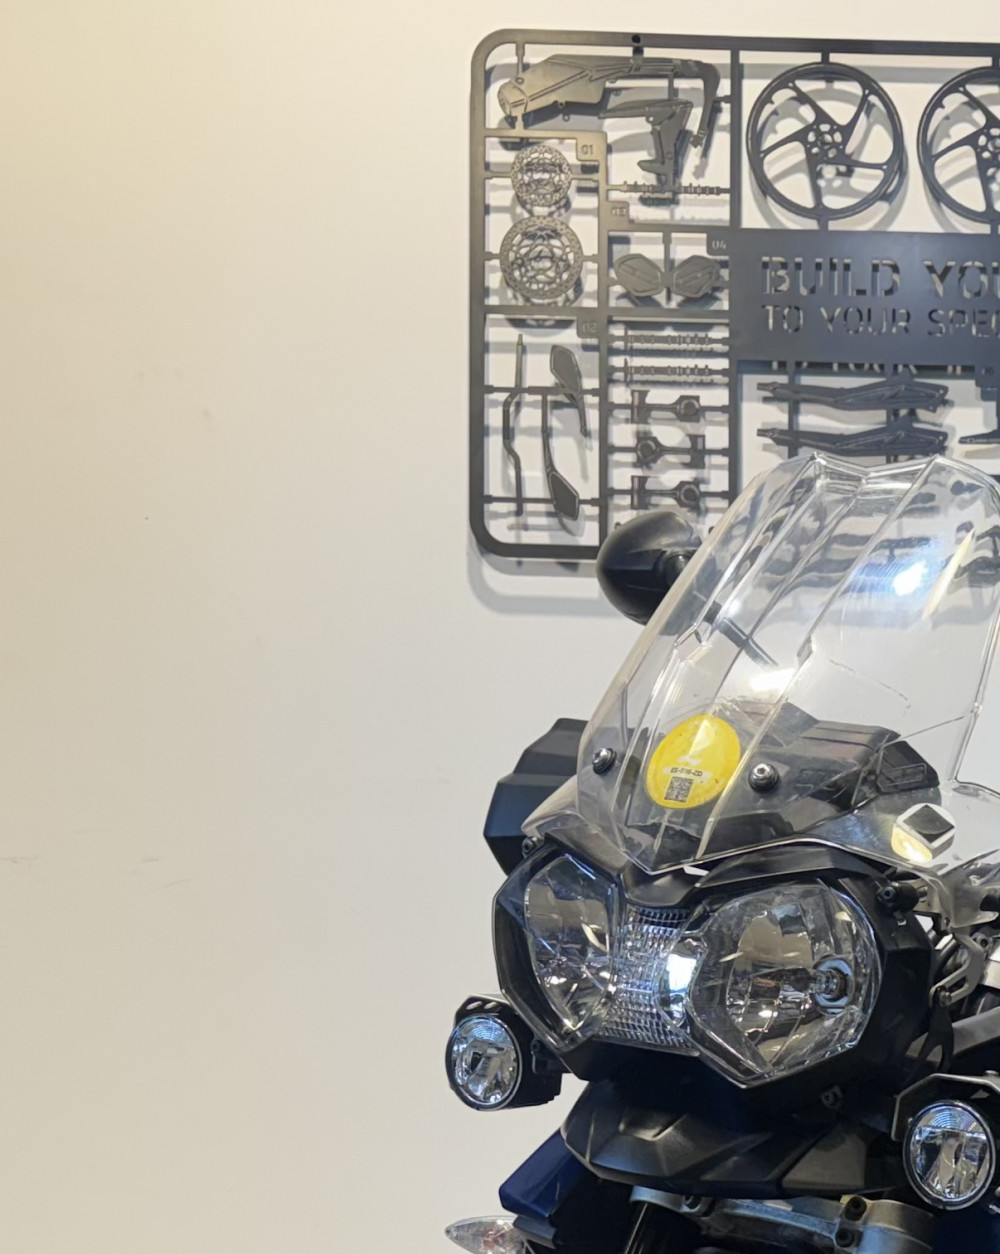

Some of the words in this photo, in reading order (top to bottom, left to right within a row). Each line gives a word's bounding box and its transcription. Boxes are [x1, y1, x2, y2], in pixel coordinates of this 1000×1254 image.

[580, 144, 595, 155] 01
[711, 239, 727, 250] 04
[761, 256, 900, 297] BUILD
[761, 304, 804, 333] TO
[820, 306, 912, 336] YOUR
